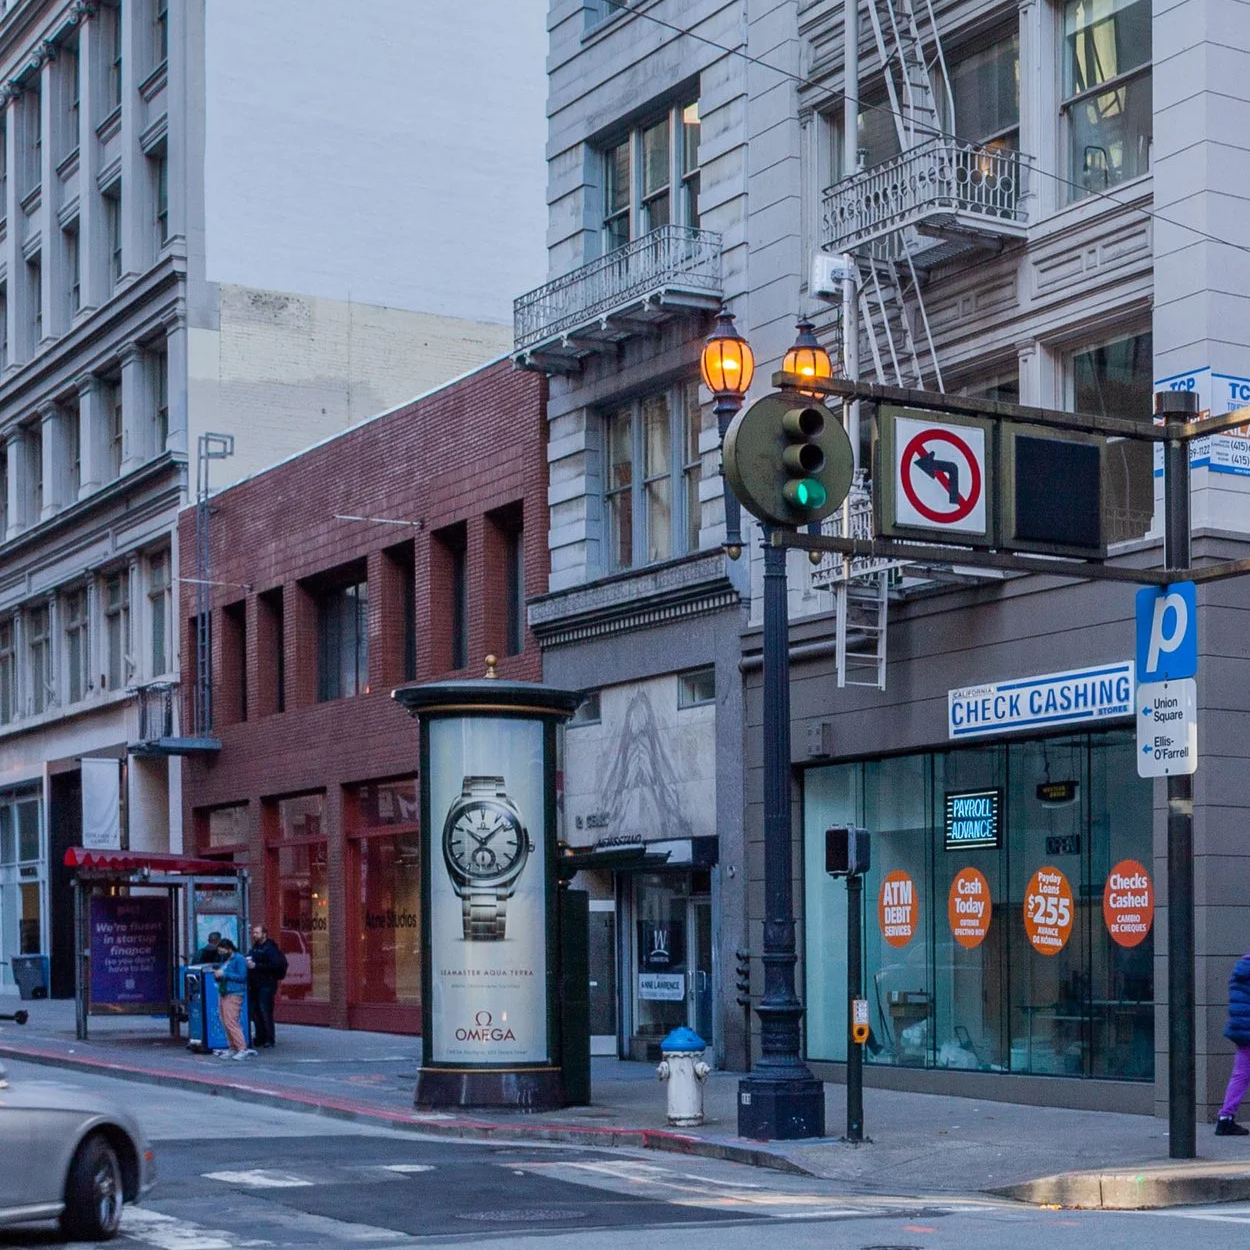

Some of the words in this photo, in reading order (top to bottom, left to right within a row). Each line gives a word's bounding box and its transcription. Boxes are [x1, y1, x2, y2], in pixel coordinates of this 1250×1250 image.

[953, 686, 993, 699] CALIFORNIA
[952, 694, 1021, 726] CHECK
[1029, 676, 1130, 715] CASHING
[1154, 697, 1178, 710] Union
[1098, 704, 1128, 716] STORES
[1153, 709, 1183, 723] Square
[1154, 736, 1174, 747] Ellis-
[1154, 746, 1189, 760] O'Farrell
[953, 798, 992, 818] PAYROLL
[951, 819, 993, 840] ADVANCE
[1038, 872, 1061, 885] Payday
[1110, 874, 1147, 890] Checks
[883, 880, 912, 906] ATM
[957, 878, 982, 895] Cash
[1039, 883, 1060, 894] Loans
[955, 897, 985, 917] Today
[1109, 892, 1149, 908] Cashed
[885, 906, 911, 924] DEBIT
[1028, 894, 1070, 926] $255
[1117, 914, 1141, 923] CAMBIO
[96, 922, 127, 933] We're
[885, 925, 911, 937] SERVICES
[1111, 924, 1119, 932] DE
[1120, 924, 1147, 933] CHEQUES
[654, 929, 667, 951] W
[483, 969, 508, 977] AQUA
[510, 969, 534, 977] TERRA
[456, 1028, 516, 1042] OMEGA
